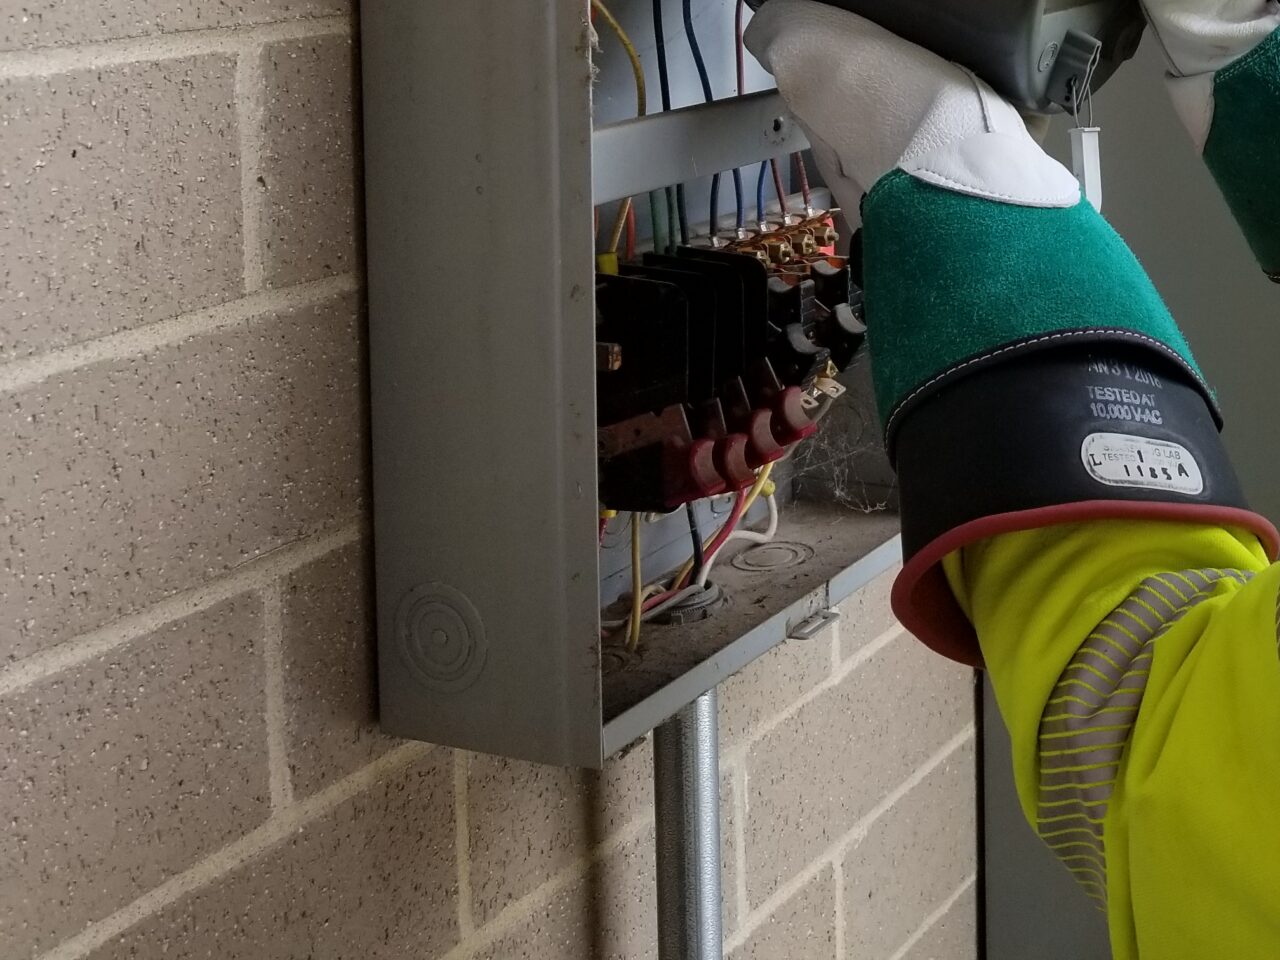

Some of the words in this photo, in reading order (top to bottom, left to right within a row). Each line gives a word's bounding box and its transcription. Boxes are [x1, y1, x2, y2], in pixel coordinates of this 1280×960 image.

[1087, 386, 1141, 404] TESTED
[1141, 394, 1155, 407] AT
[1090, 402, 1132, 420] 10,000
[1164, 449, 1181, 460] LAB
[1177, 463, 1189, 478] A
